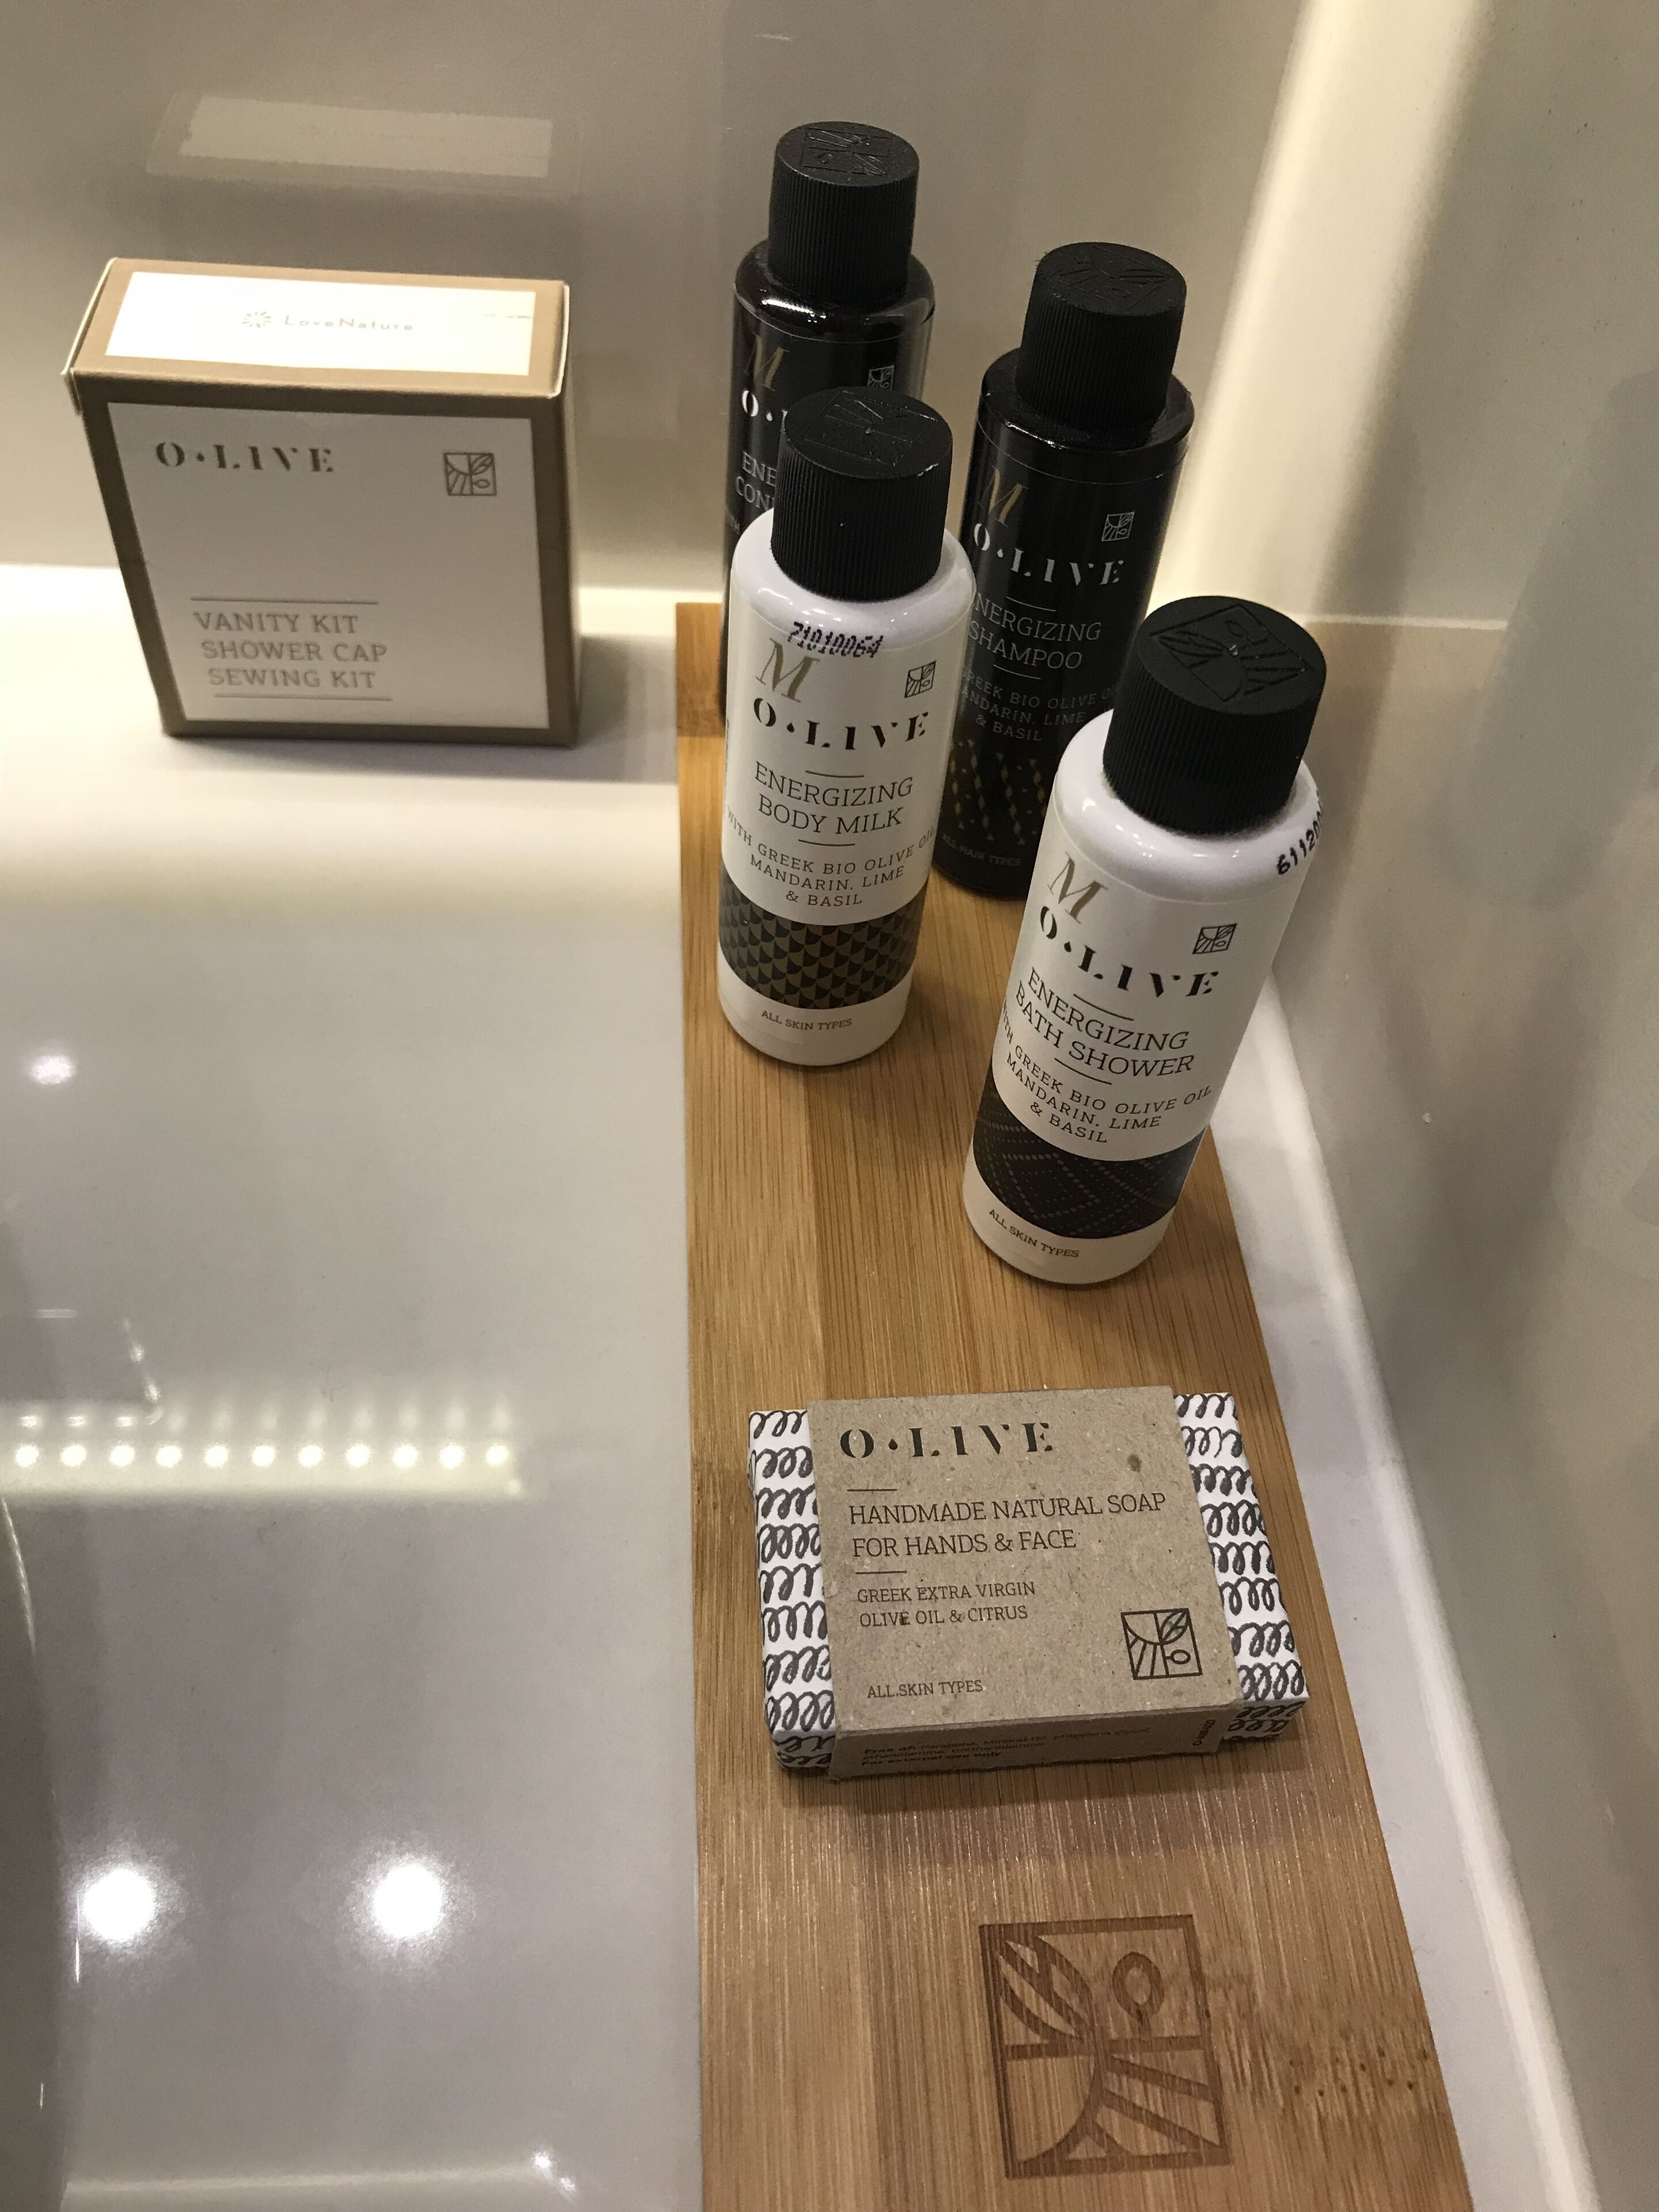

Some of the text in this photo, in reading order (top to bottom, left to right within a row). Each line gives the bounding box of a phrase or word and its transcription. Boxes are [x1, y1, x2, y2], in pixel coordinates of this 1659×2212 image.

[285, 315, 413, 331] LoveNature
[192, 611, 358, 634] VANITY KIT
[975, 592, 1101, 642] NERGIZING
[202, 639, 387, 662] SHOWER CAP
[968, 620, 1082, 669] SHAMPOO
[208, 668, 376, 688] SEWING KIT
[755, 638, 820, 703] M
[1010, 692, 1040, 708] BIO
[1048, 692, 1097, 709] OLIVE
[975, 714, 1042, 741] & BASIL
[1044, 711, 1086, 726] LIME
[755, 760, 913, 807] ENERGIZING
[759, 794, 904, 835] BODY MILK
[757, 843, 813, 873] GREEK
[823, 862, 856, 874] BIO
[865, 844, 915, 871] OLIVE
[862, 865, 905, 888] LIME
[1048, 852, 1108, 924] M
[786, 891, 862, 907] & BASIL
[762, 1009, 853, 1031] ALL SKIN TYPES
[1028, 967, 1190, 1051] ENERGIZING
[1016, 980, 1195, 1078] BATH SHOWER
[1015, 1045, 1063, 1094] GREEK
[1069, 1089, 1106, 1111] BIO
[1115, 1098, 1177, 1115] OLIVE
[1184, 1085, 1211, 1105] OIL
[1030, 1101, 1108, 1143] & BASIL
[1109, 1116, 1162, 1130] LIME
[989, 1209, 1080, 1258] ALL SKIN TYPES
[849, 1493, 1166, 1524] HANDMADE NATURAL SOAP
[853, 1529, 1077, 1557] FOR HANDS & FACE
[857, 1581, 1036, 1603] GREEK EXTRA VIRGIN
[859, 1605, 1028, 1627] OLIVE OIL & CITRUS
[867, 1679, 983, 1698] ALL SKIN TYPES
